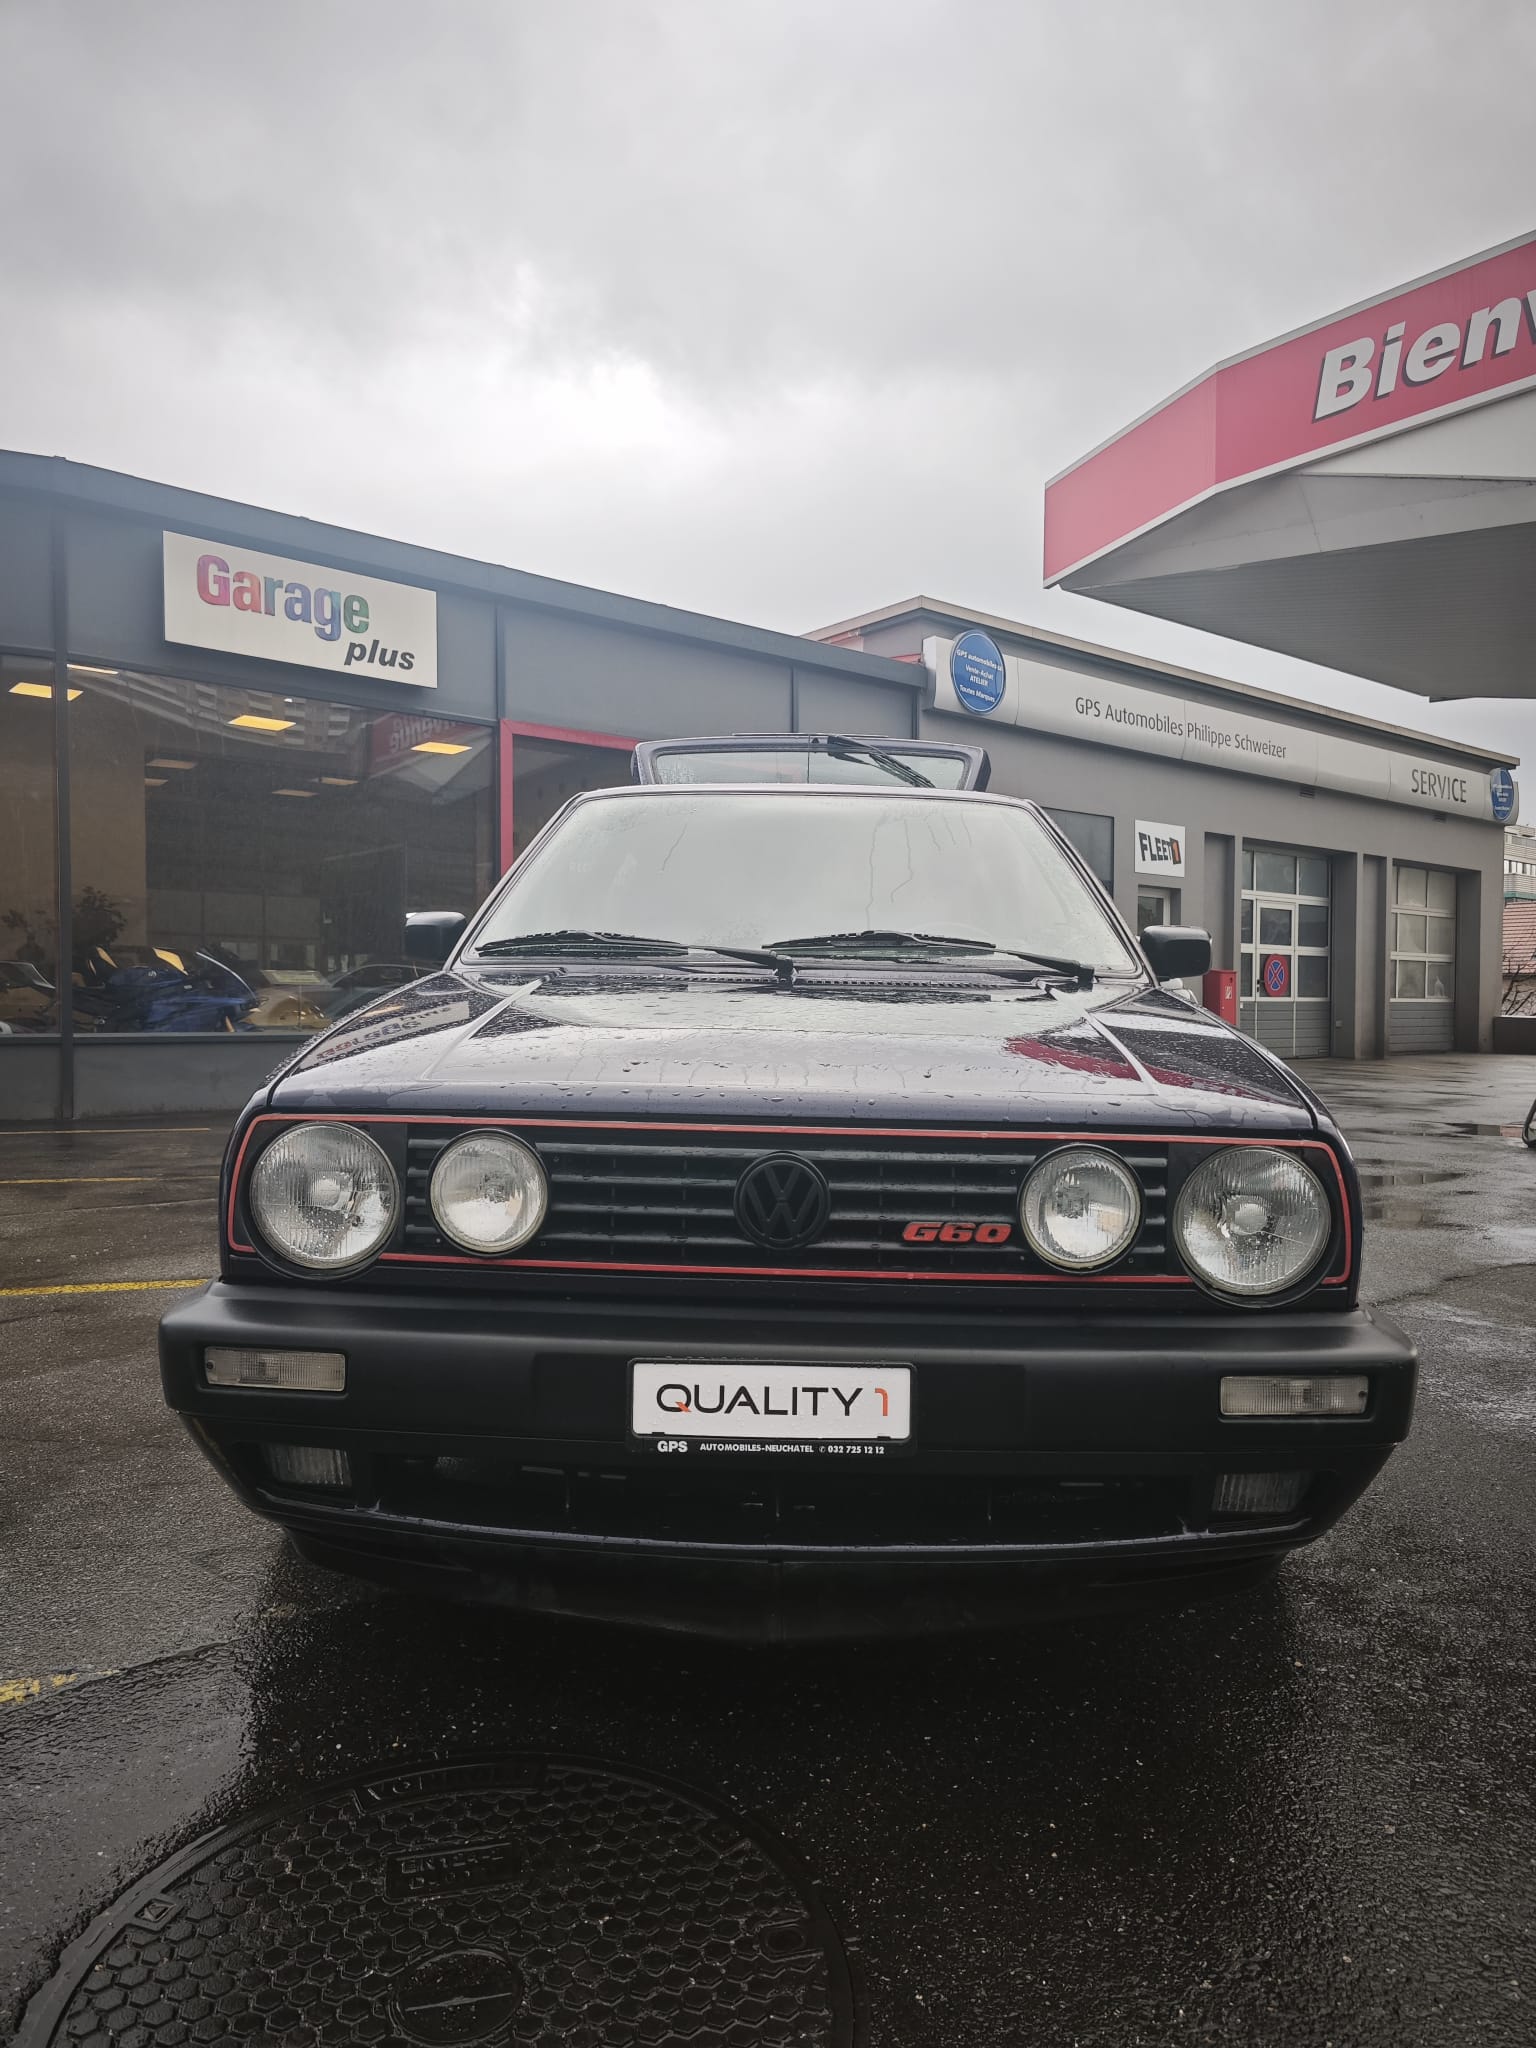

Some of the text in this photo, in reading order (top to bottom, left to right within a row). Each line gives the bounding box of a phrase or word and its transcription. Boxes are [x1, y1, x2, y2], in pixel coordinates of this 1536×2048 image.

[1312, 289, 1536, 423] Bien
[196, 554, 370, 641] Garage
[344, 639, 415, 670] plus
[969, 675, 988, 687] ATELIER
[1075, 697, 1287, 759] GPS Automobiles Philippe Schweizer
[1411, 768, 1467, 804] SERVICE
[902, 1221, 1012, 1244] G60
[657, 1440, 885, 1455] GPS AUTOMOBILES-NEUCHATEL 032 725 12 12
